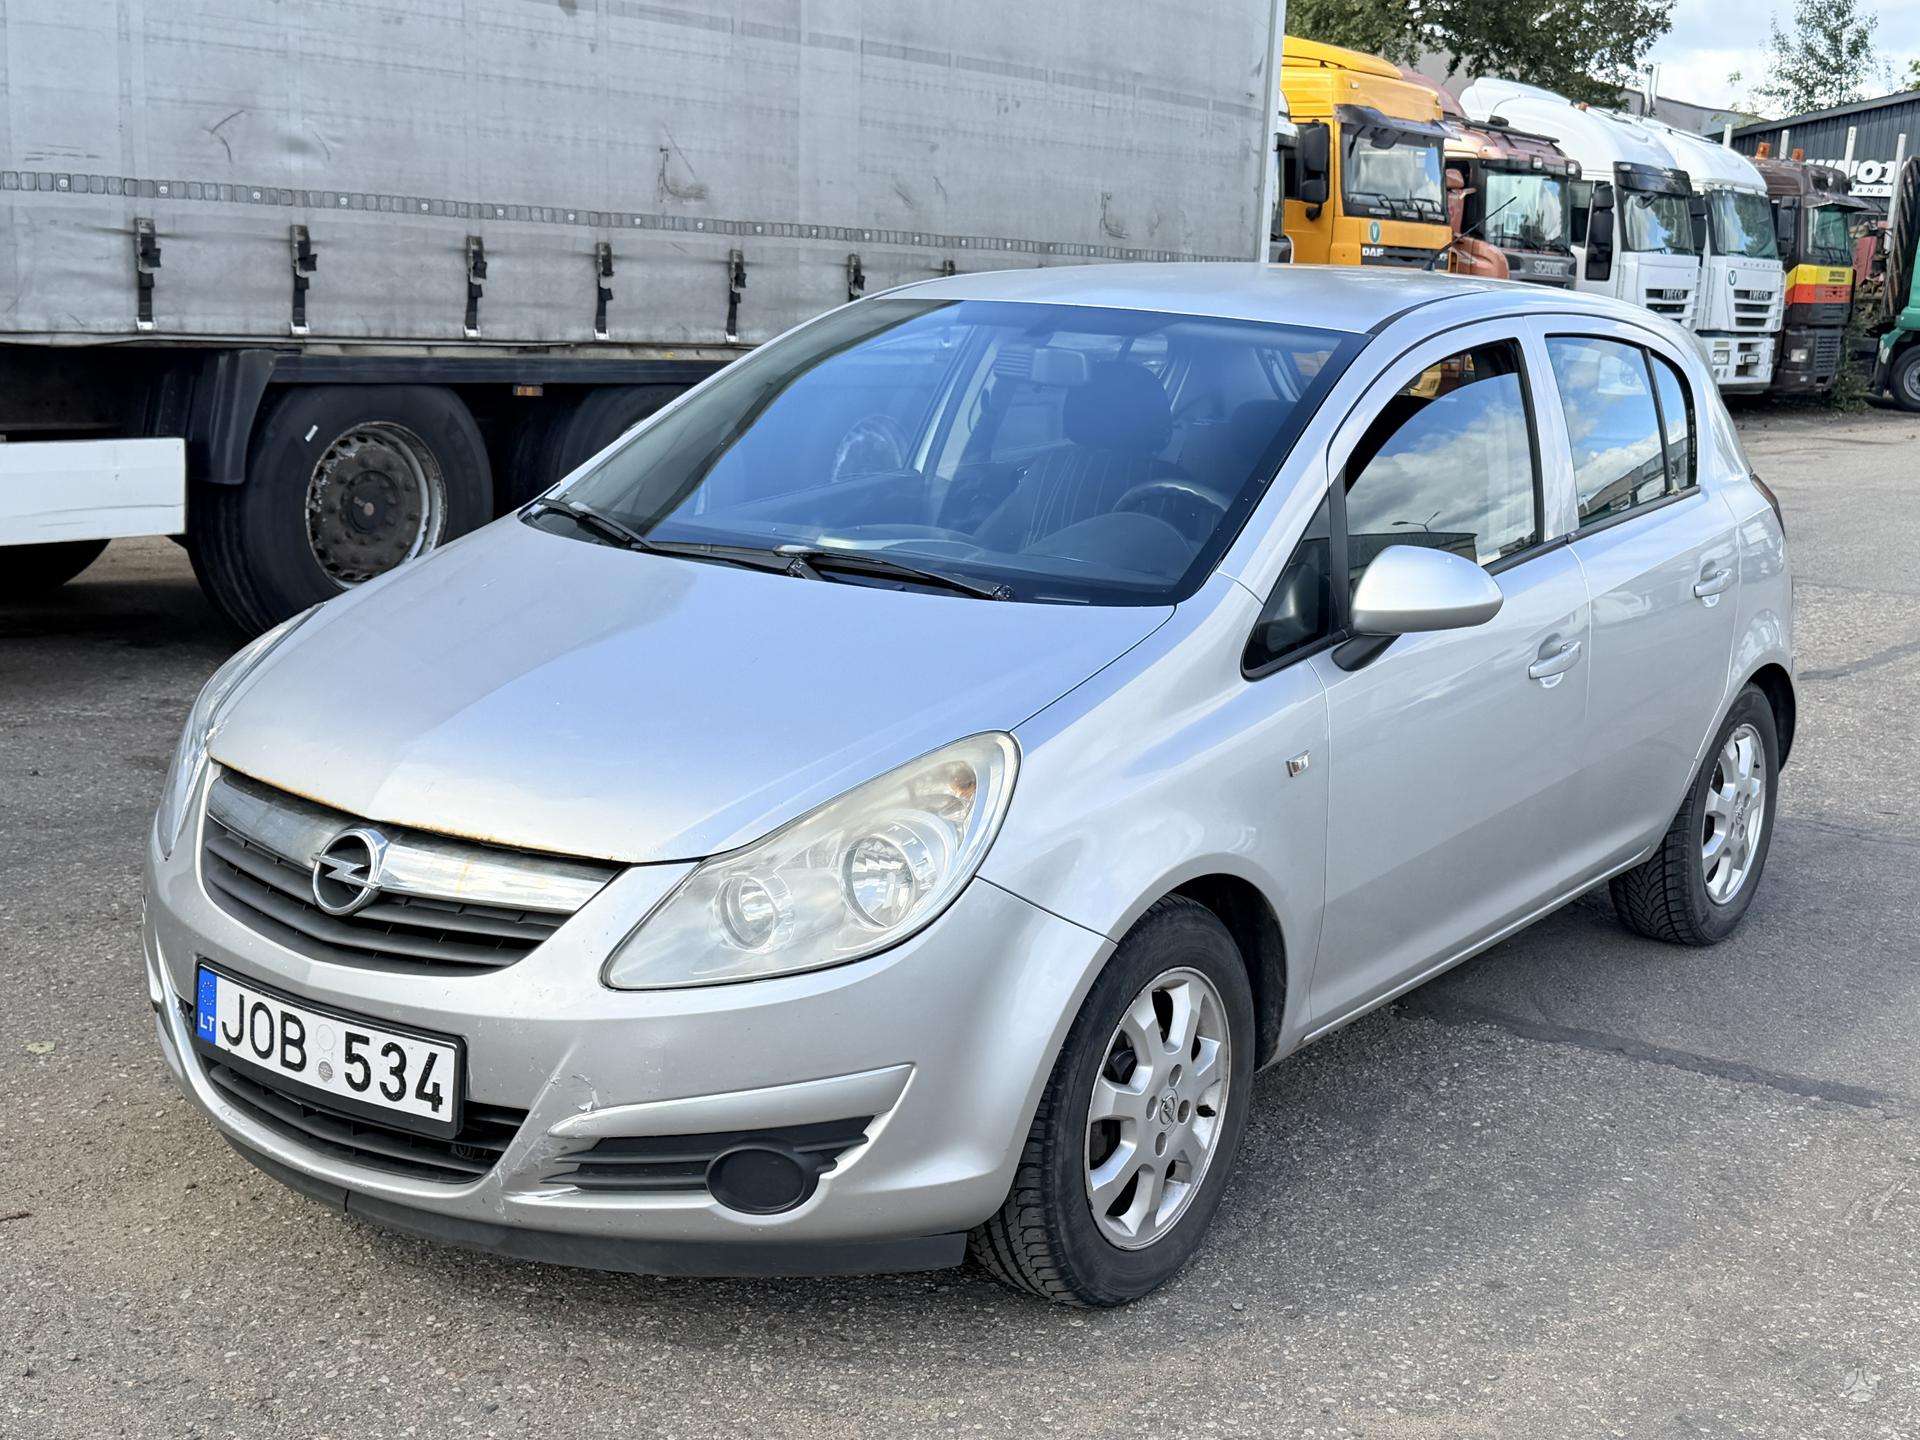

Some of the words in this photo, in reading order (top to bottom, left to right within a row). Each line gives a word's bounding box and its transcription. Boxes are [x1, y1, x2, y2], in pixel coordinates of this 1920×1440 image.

[1362, 247, 1384, 257] DAF
[200, 1012, 215, 1032] LT
[222, 993, 307, 1073] JOB
[344, 1031, 443, 1113] 534
